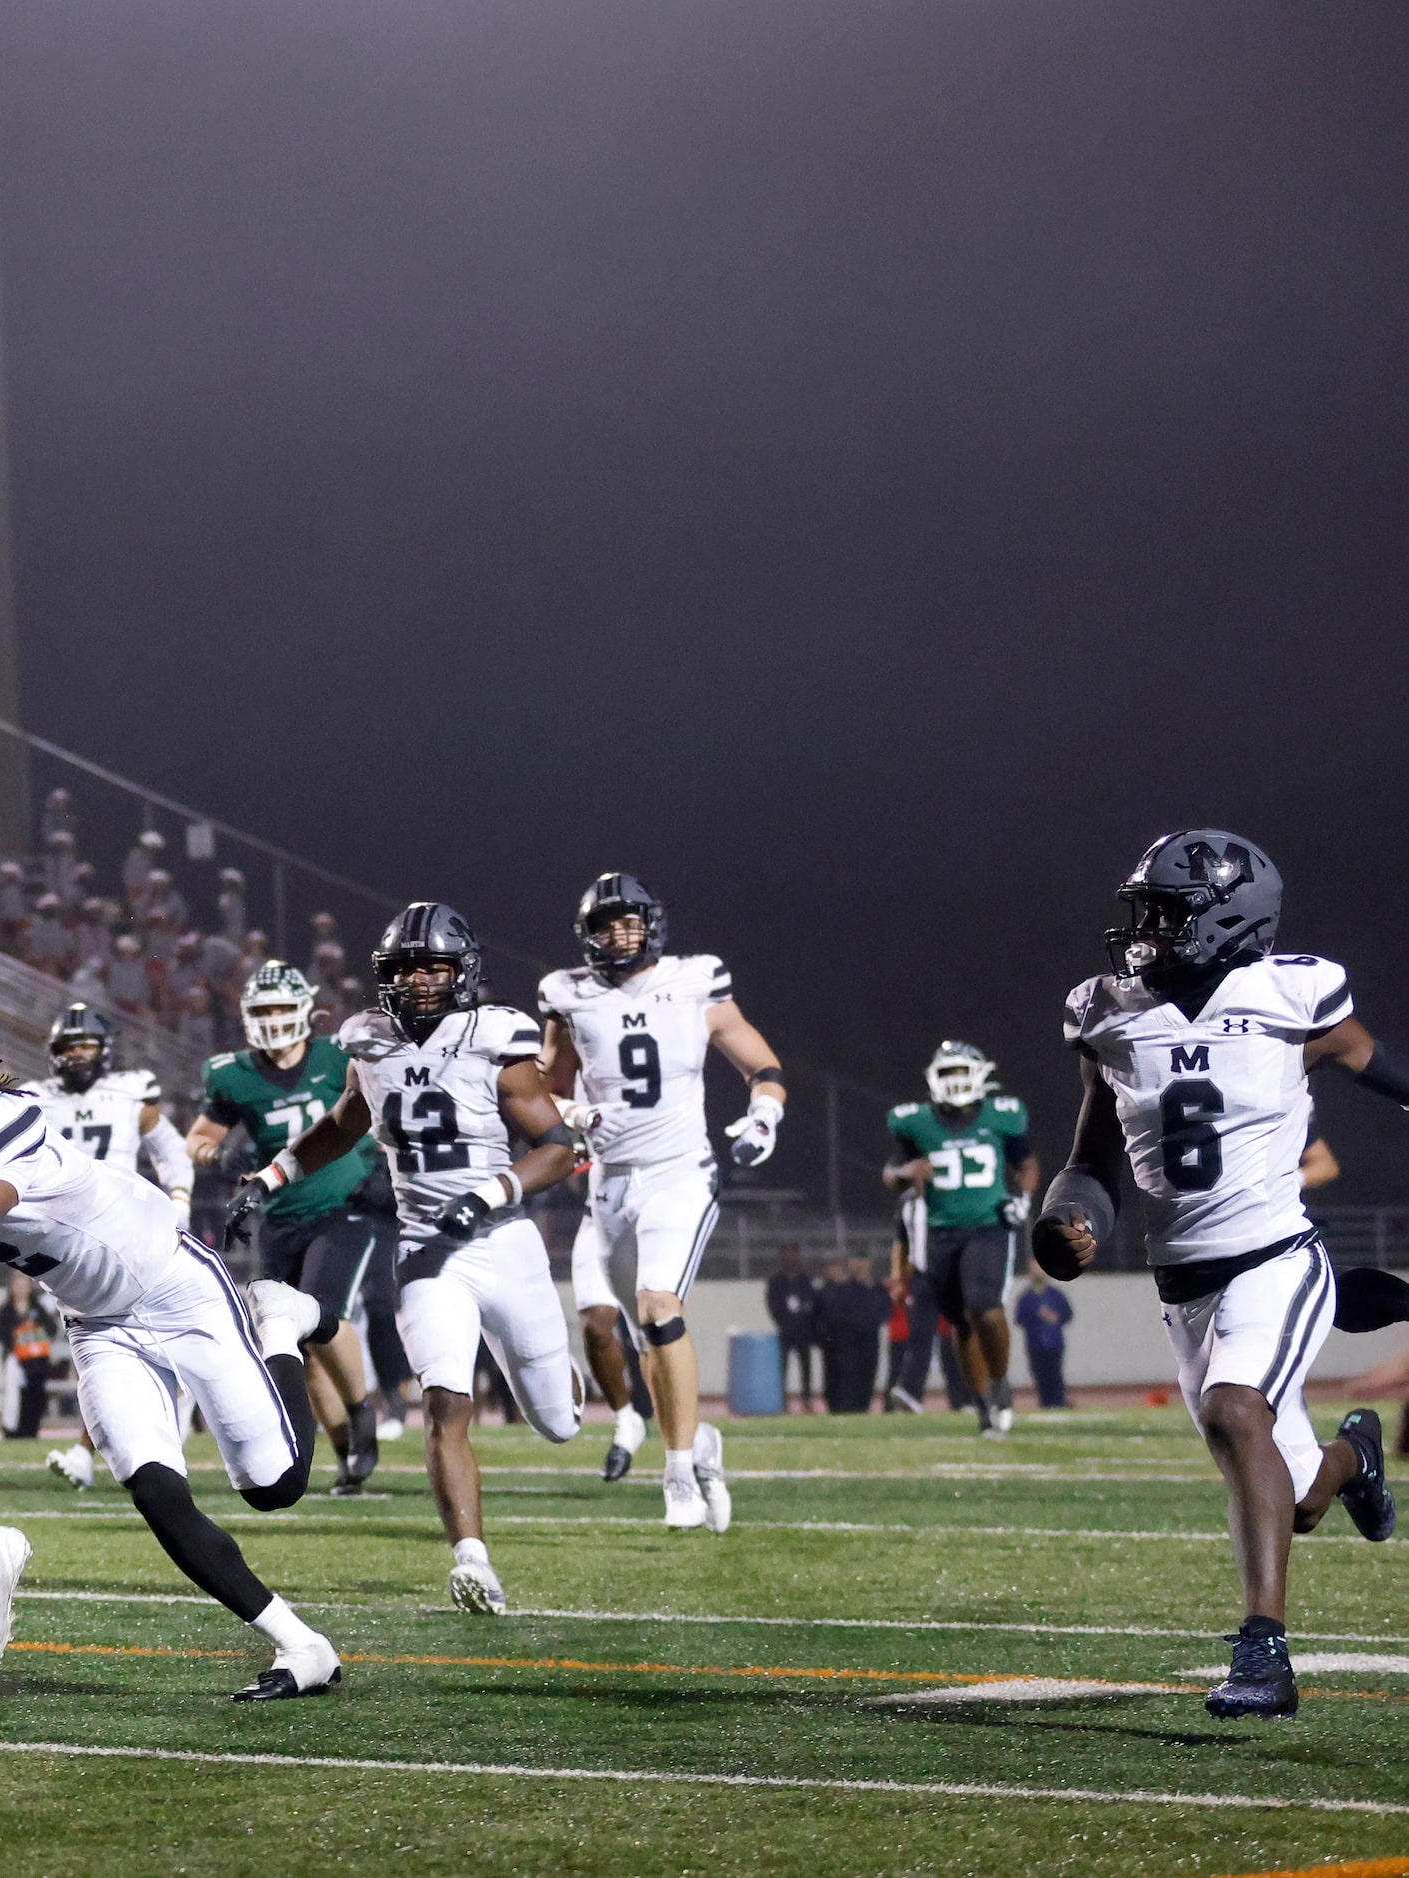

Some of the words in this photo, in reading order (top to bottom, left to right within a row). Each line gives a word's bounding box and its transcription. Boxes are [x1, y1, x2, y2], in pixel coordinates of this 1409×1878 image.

[622, 1012, 647, 1029] M
[618, 1033, 662, 1108] 9
[1170, 1045, 1210, 1074] M
[404, 1066, 430, 1087] M
[75, 1109, 93, 1122] M
[382, 1091, 471, 1173] 12
[1160, 1078, 1224, 1191] 6
